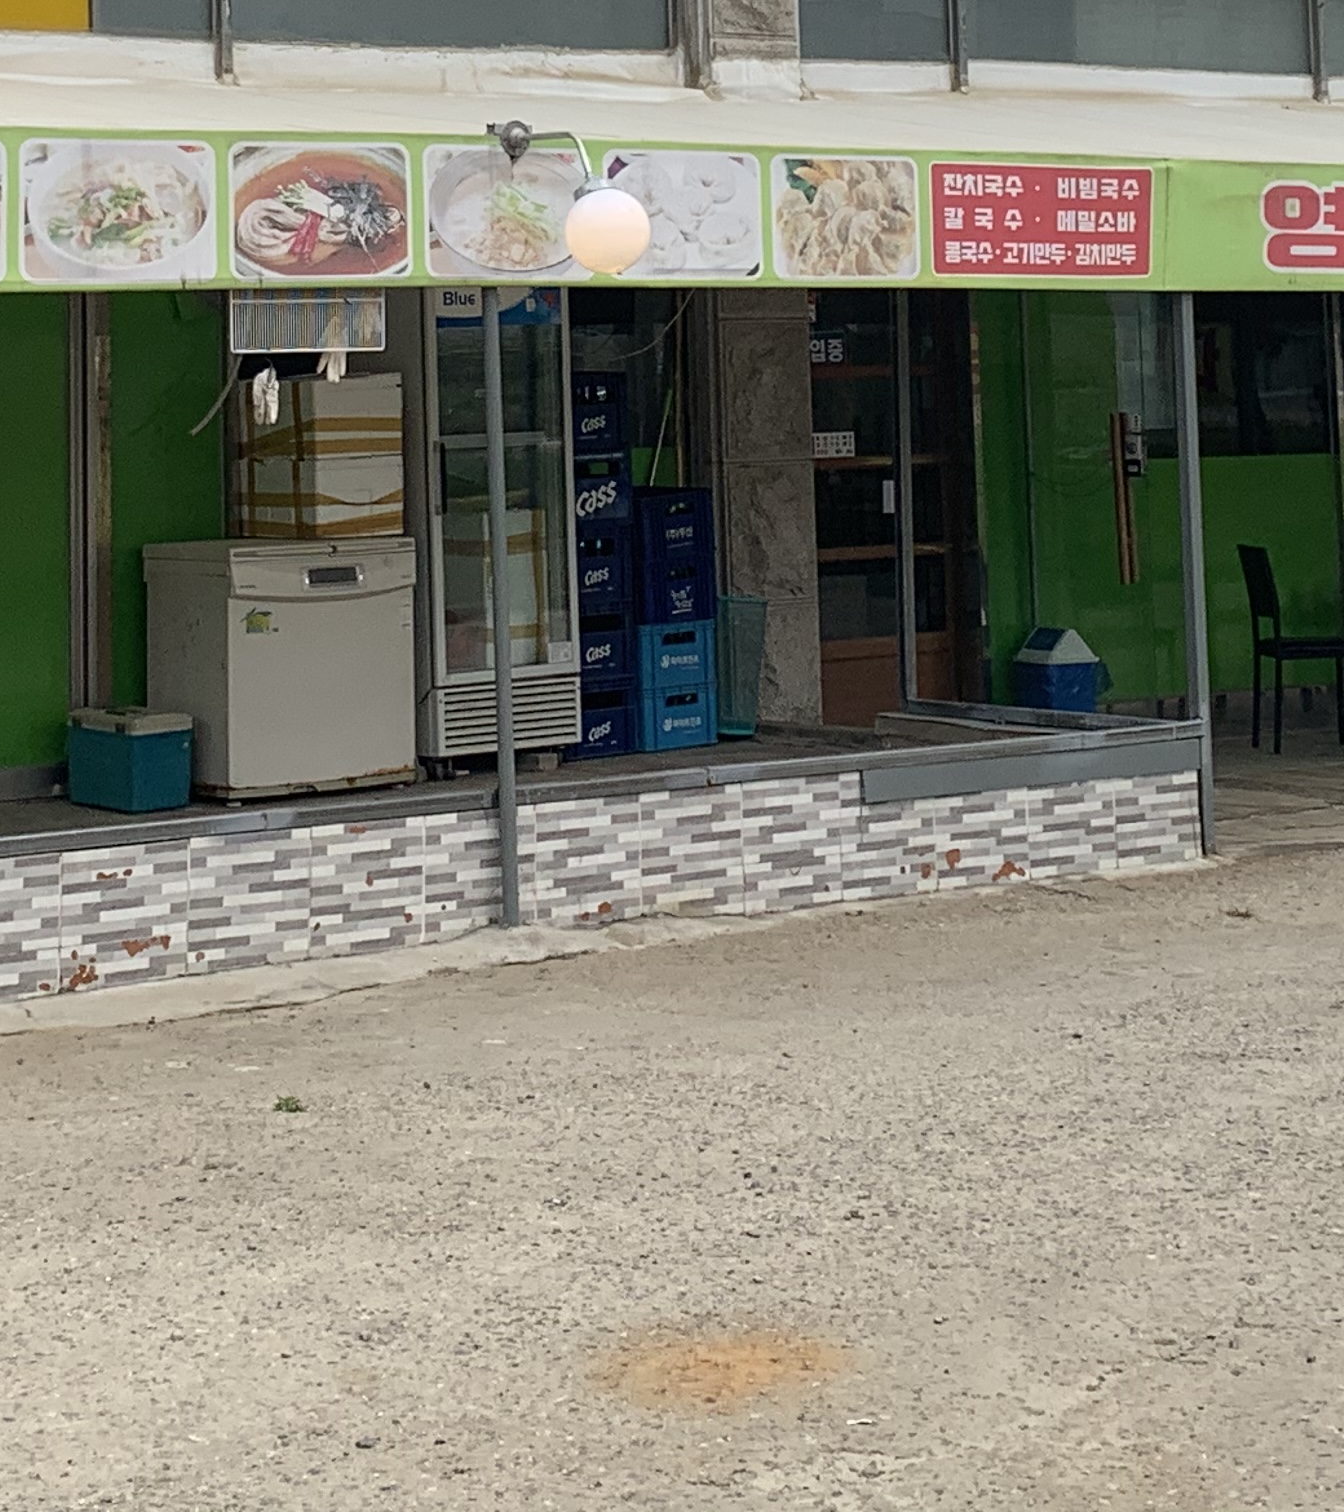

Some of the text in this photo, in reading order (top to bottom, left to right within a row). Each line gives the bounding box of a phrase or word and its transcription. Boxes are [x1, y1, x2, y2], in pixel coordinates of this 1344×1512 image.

[943, 173, 1025, 197] 잔치국수
[1056, 177, 1141, 200] 비빔국수
[1056, 210, 1137, 232] 메밀소바
[442, 291, 476, 306] Blue
